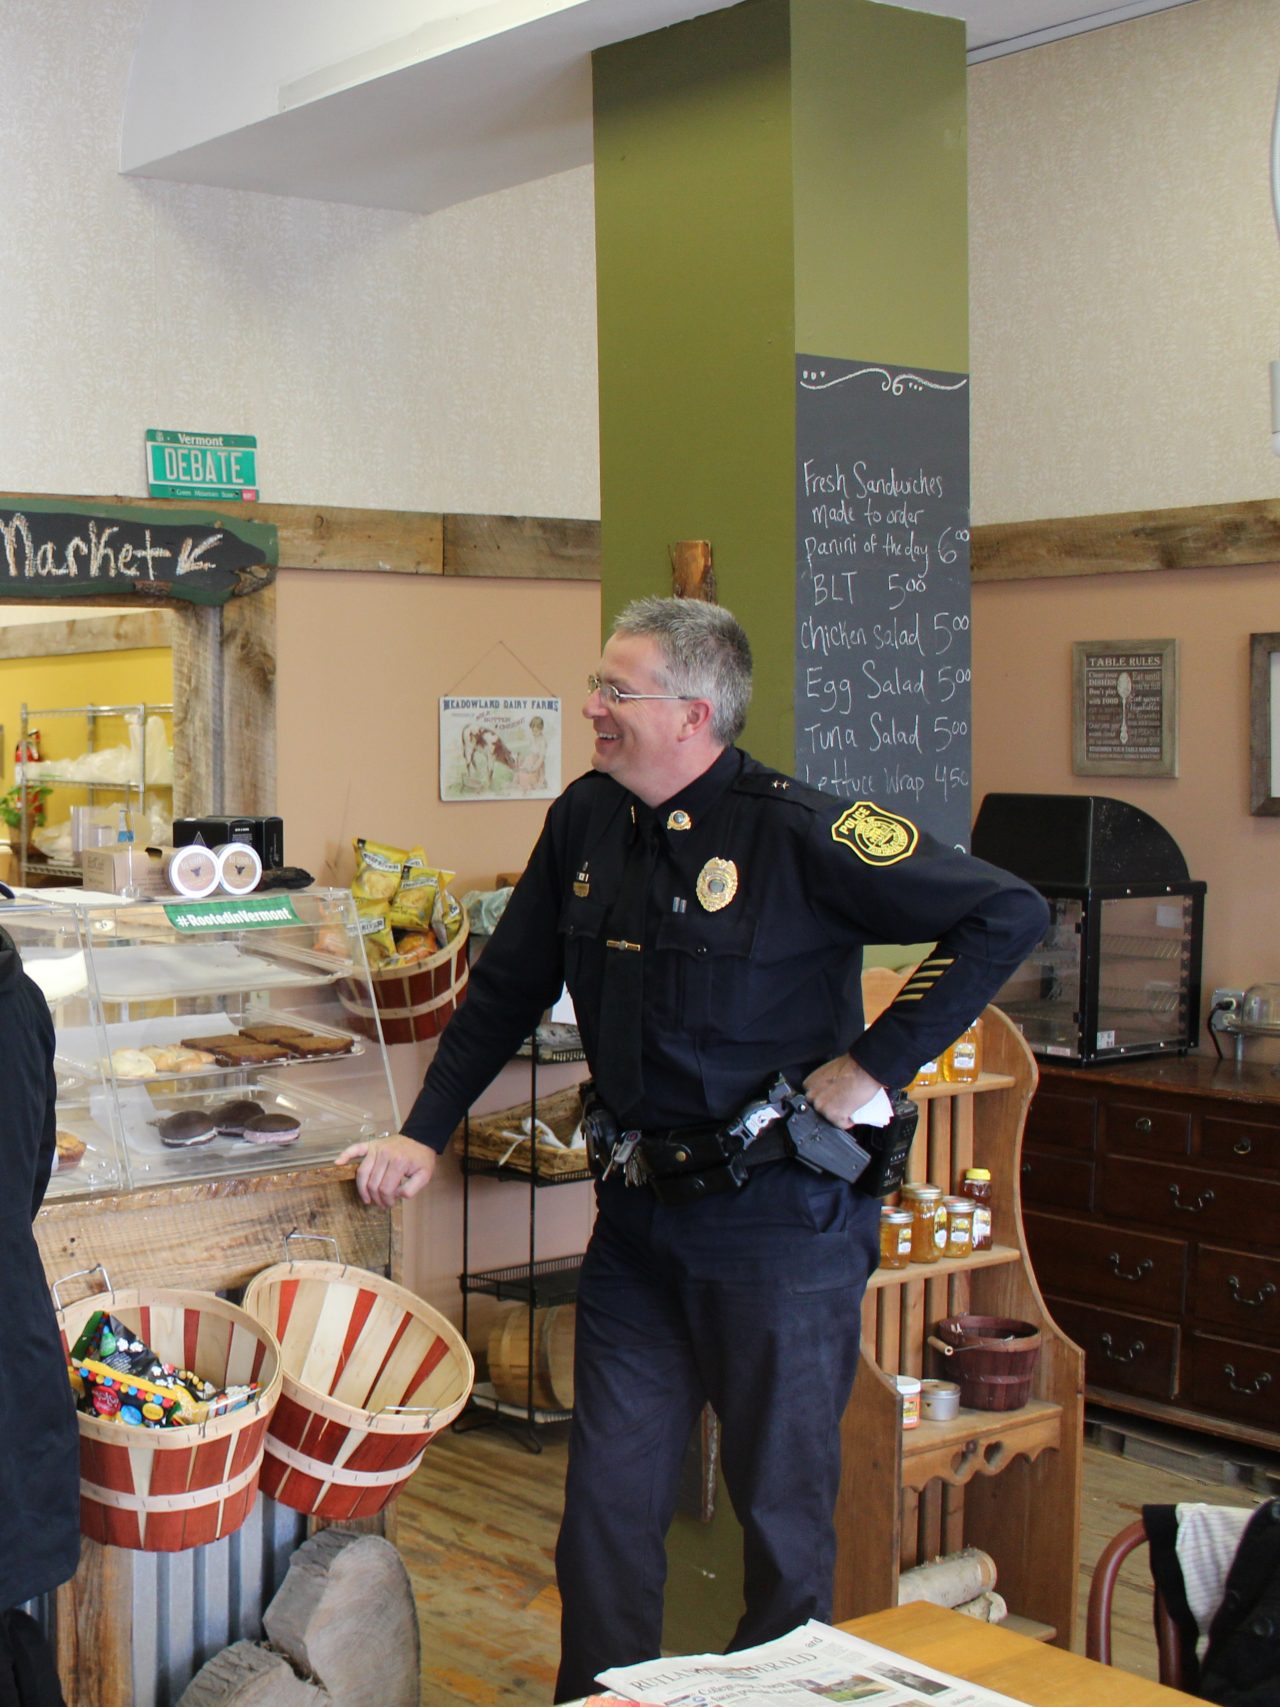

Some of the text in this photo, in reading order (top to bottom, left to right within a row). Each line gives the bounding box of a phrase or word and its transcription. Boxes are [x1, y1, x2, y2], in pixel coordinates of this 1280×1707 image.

[178, 433, 224, 447] Vermont
[164, 447, 244, 484] DEBATE
[803, 459, 943, 500] Fresh Sandwiches
[864, 498, 882, 526] to
[886, 501, 924, 528] order
[863, 533, 878, 555] of
[882, 533, 902, 557] the
[905, 531, 929, 578] day
[813, 572, 858, 606] BLT
[1089, 656, 1161, 667] TABLE RULES
[806, 666, 852, 715] Egg
[862, 660, 930, 704] Salad
[443, 699, 559, 712] MEADOWLAND DAIRY FARMS
[804, 723, 858, 753] Tuna
[870, 712, 923, 754] Salad
[884, 763, 925, 802] Wrap
[838, 806, 871, 835] POLICE
[176, 908, 292, 928] #RootedInVermont
